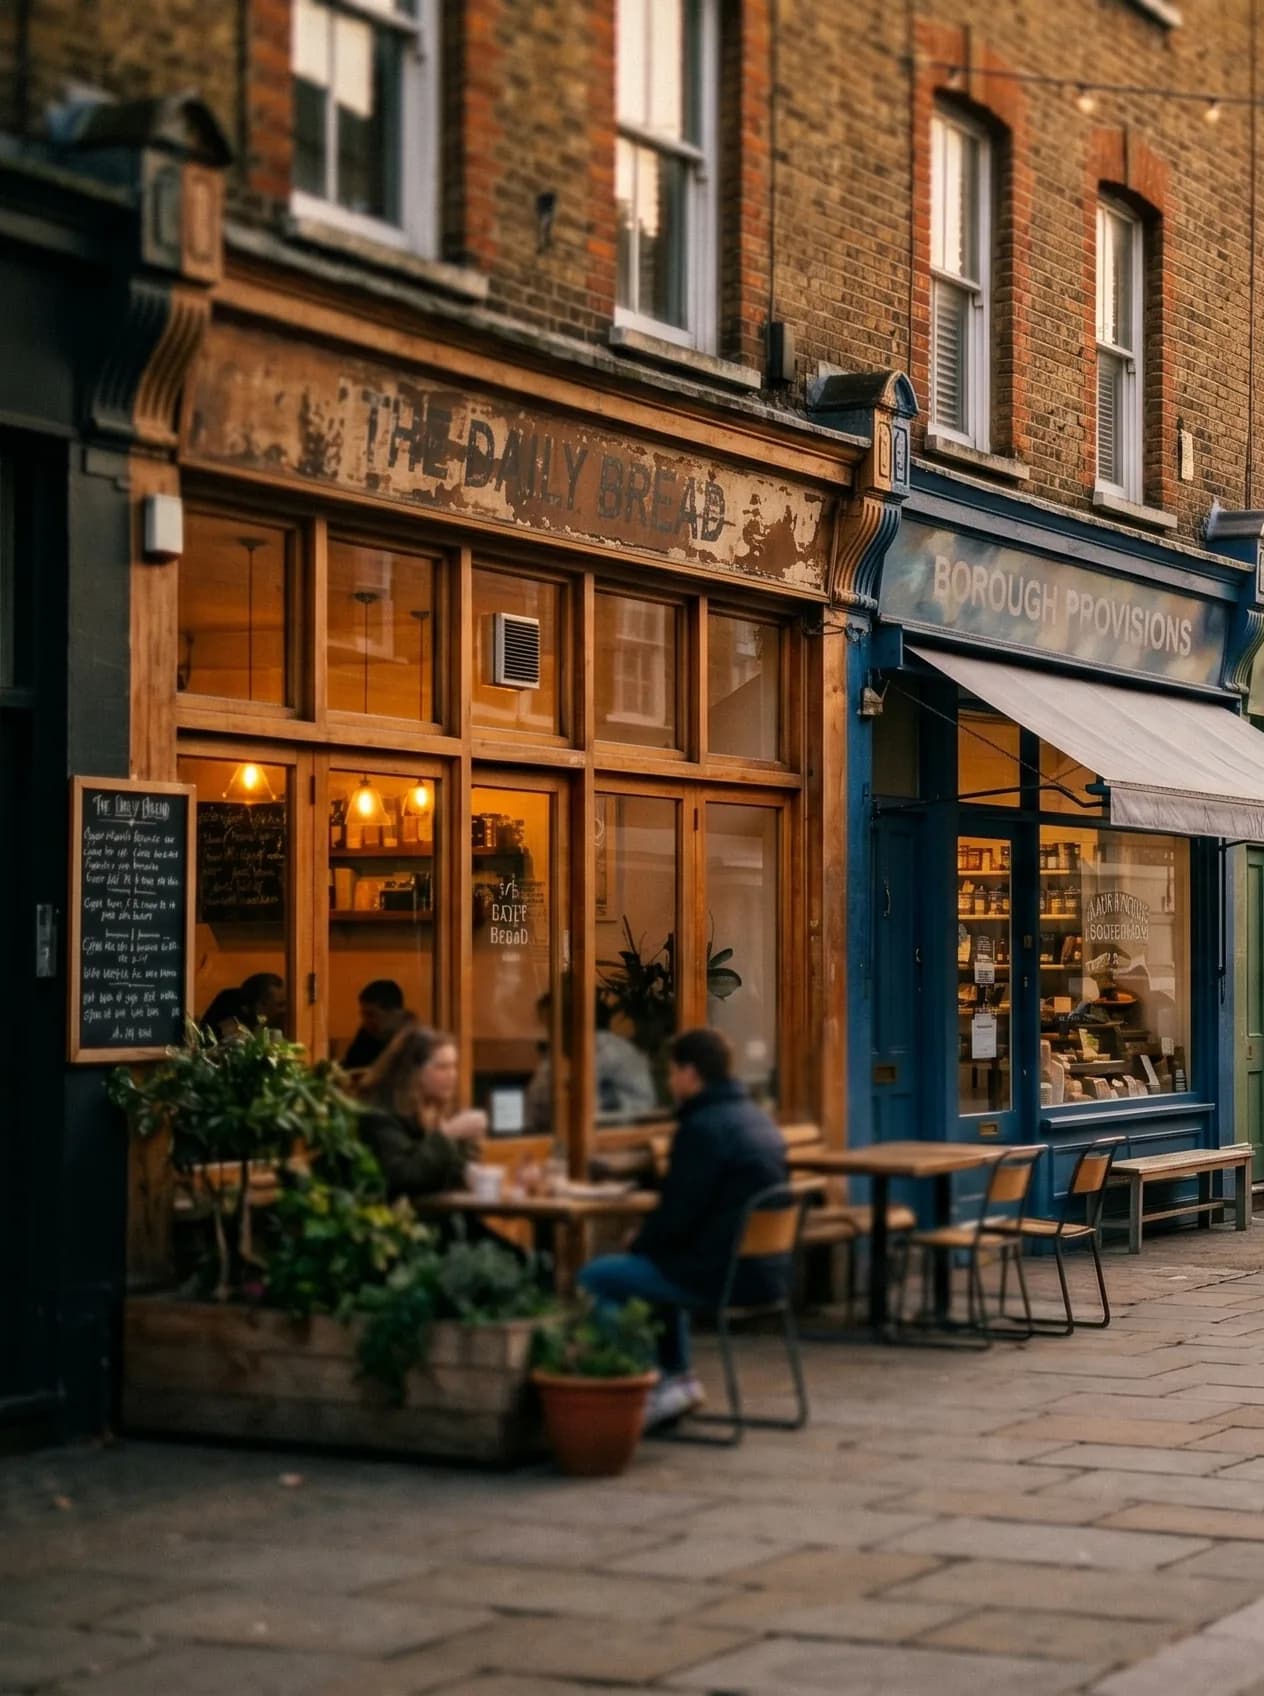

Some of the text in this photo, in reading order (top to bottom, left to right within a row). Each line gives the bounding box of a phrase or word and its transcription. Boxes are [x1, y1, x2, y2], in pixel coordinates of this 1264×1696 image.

[361, 389, 727, 542] THE DAILY BREAD
[933, 555, 1193, 656] BOROUGH PROVISIONS
